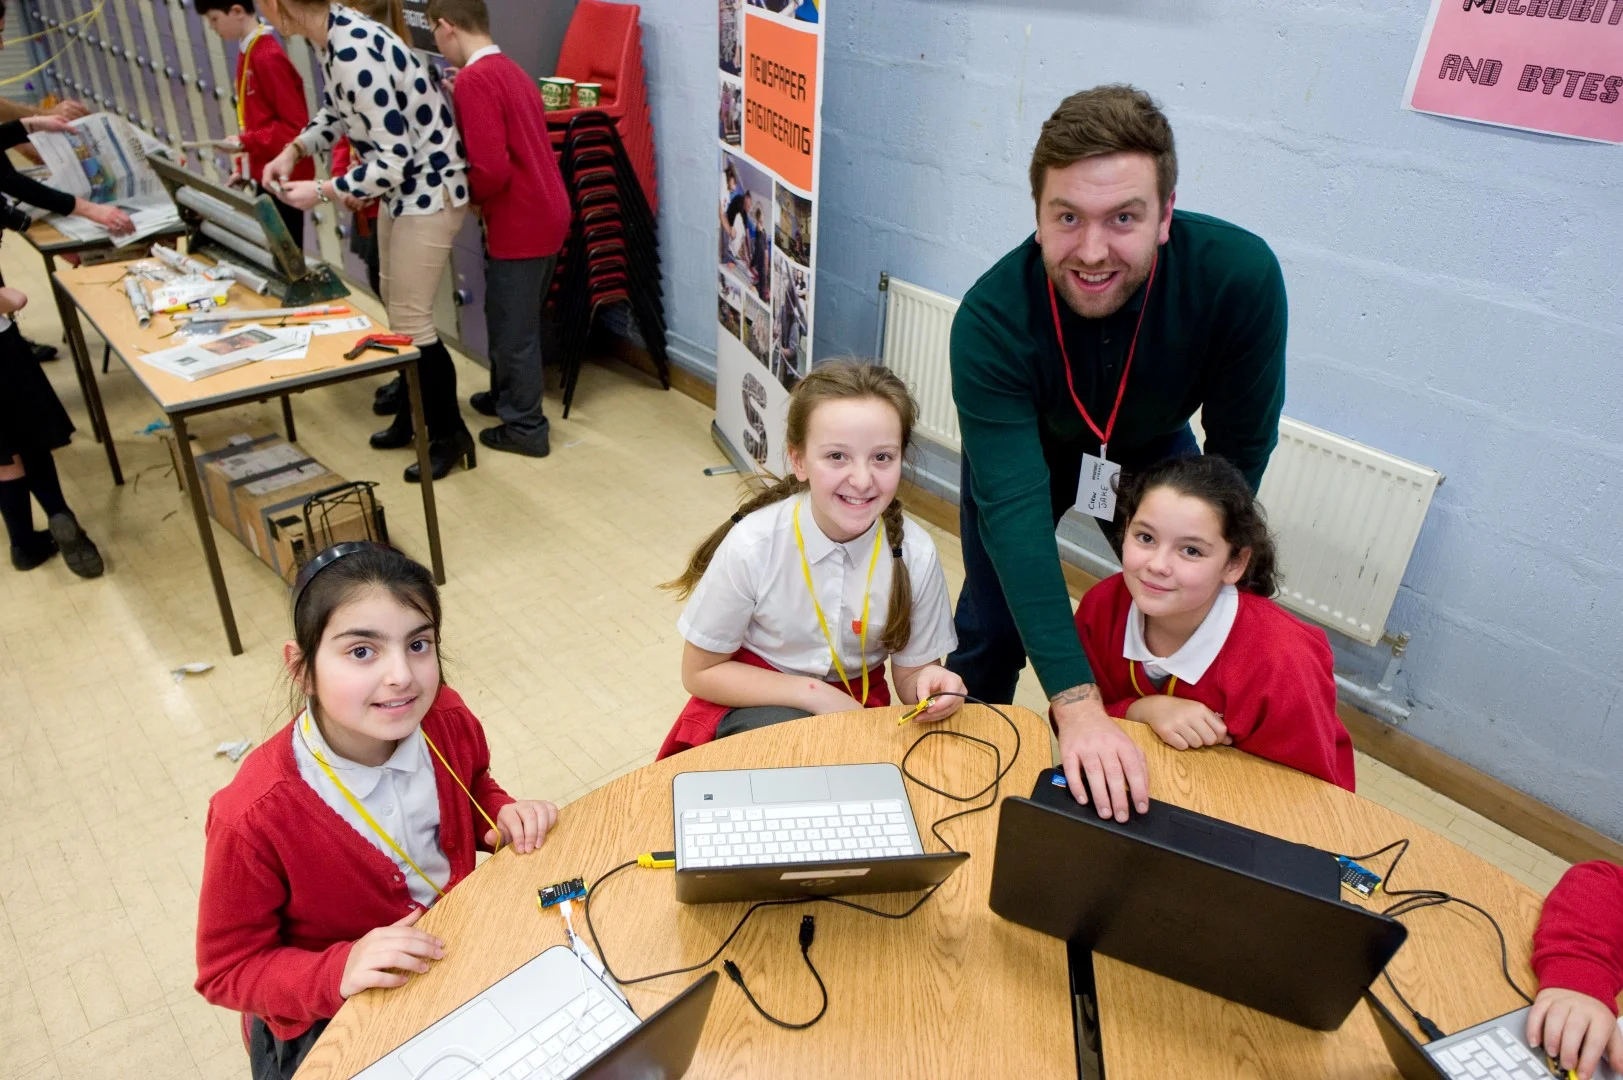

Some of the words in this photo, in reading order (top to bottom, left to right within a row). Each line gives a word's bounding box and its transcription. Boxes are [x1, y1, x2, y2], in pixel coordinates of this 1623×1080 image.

[750, 53, 806, 102] NEWSPAPER
[1438, 53, 1503, 86] AND
[1517, 64, 1623, 103] BYTES
[746, 99, 810, 155] ENGINEERING
